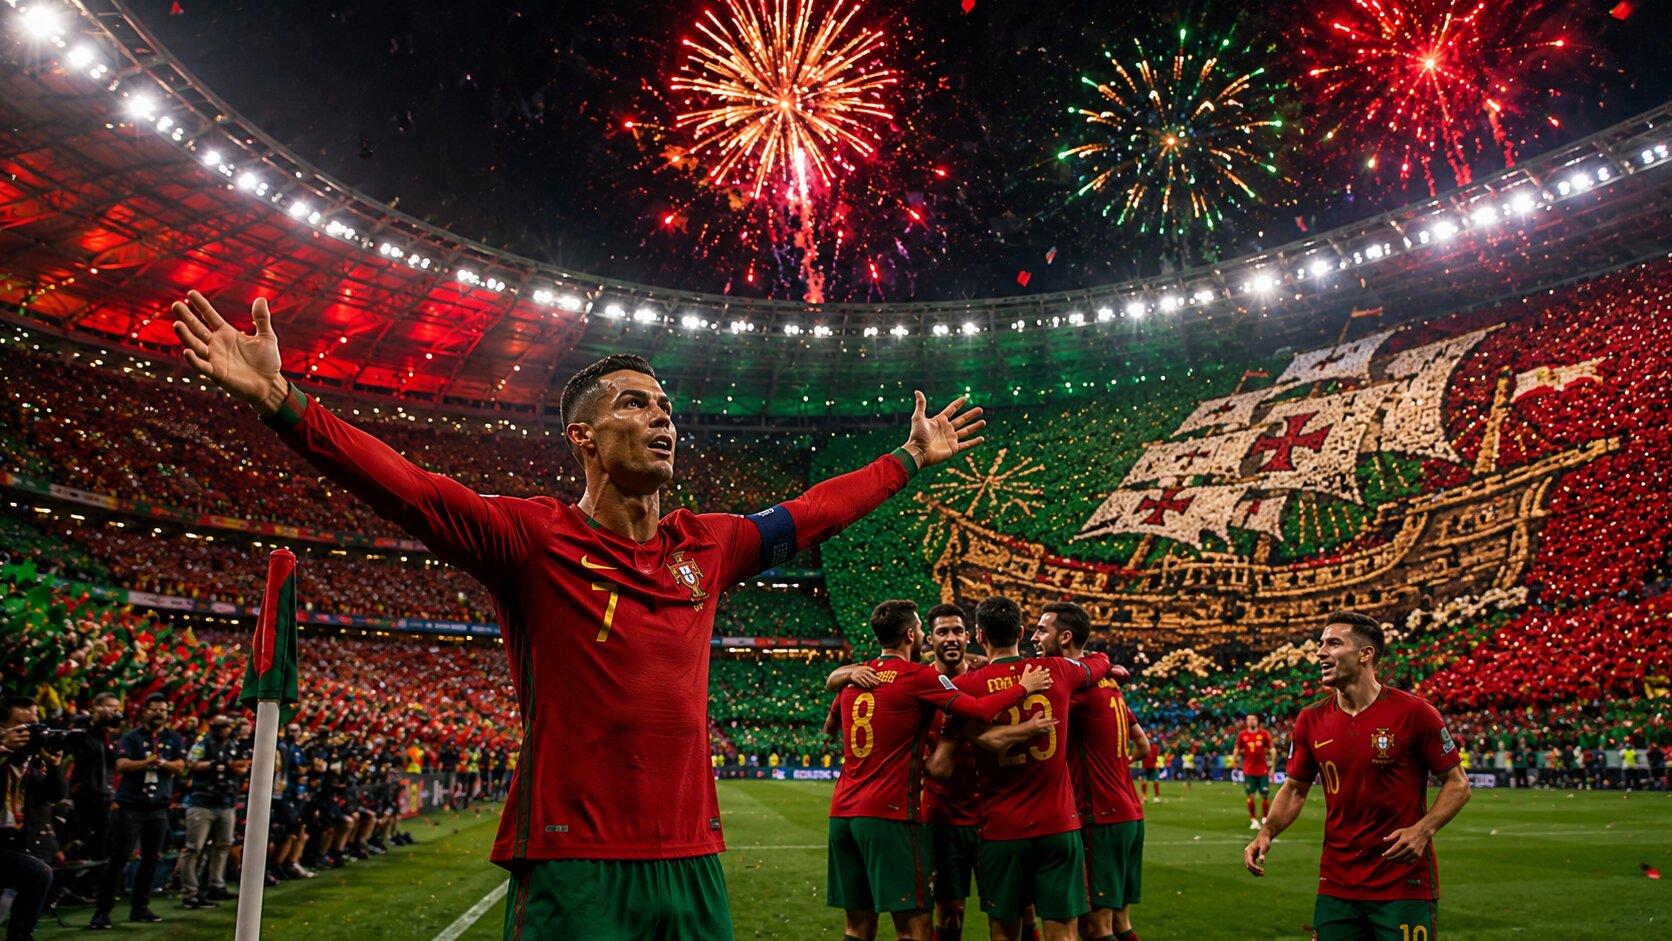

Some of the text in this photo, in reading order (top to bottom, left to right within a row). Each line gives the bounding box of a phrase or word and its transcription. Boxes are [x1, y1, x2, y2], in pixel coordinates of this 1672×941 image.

[592, 582, 618, 642] 7
[851, 692, 875, 758] 8
[1319, 760, 1340, 794] 10
[1399, 924, 1428, 941] 10
